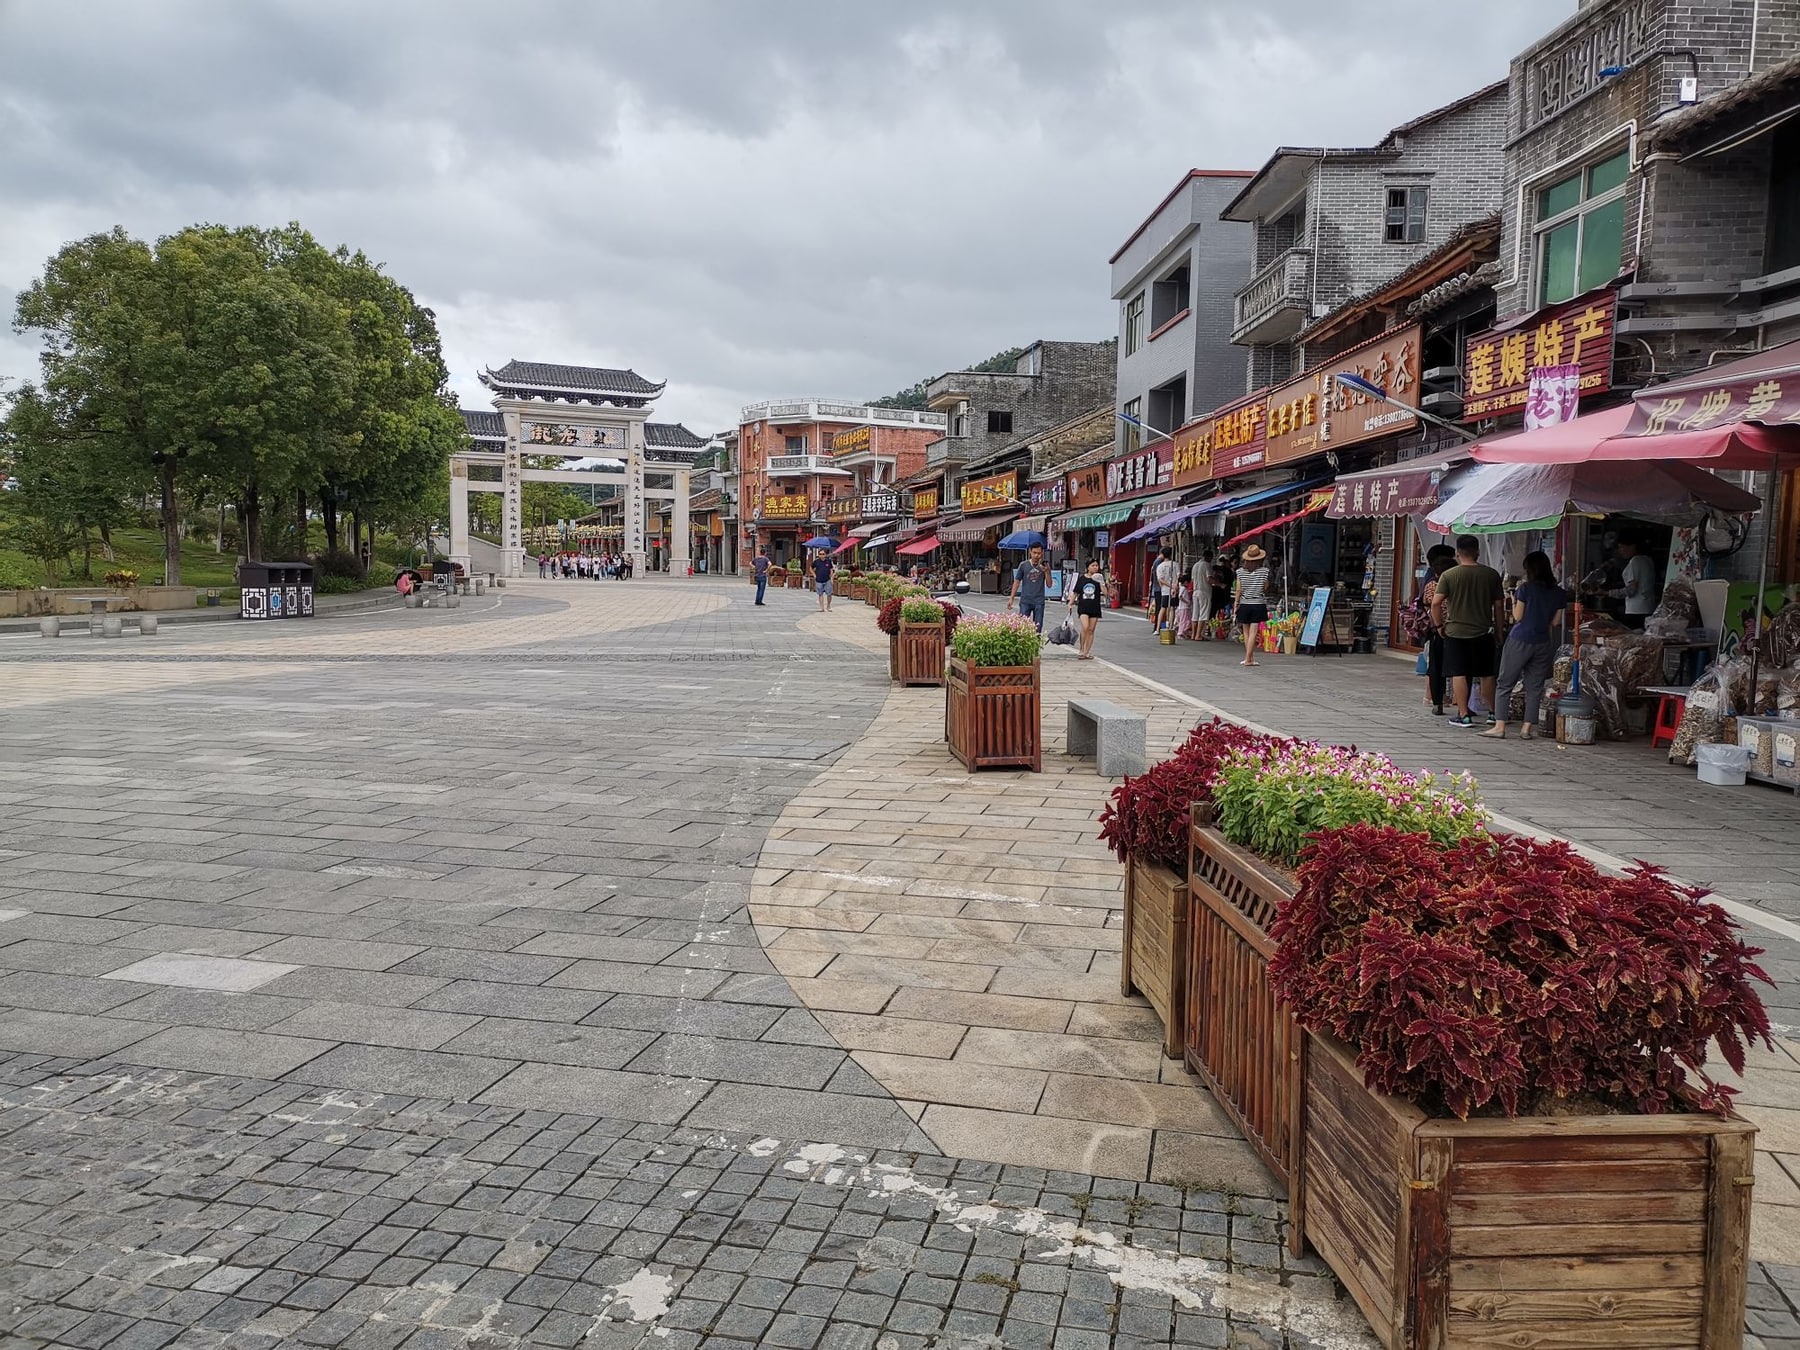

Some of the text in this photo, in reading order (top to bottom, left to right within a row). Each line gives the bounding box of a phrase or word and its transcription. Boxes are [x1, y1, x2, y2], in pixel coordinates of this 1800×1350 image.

[1214, 403, 1265, 449] 正果土特产
